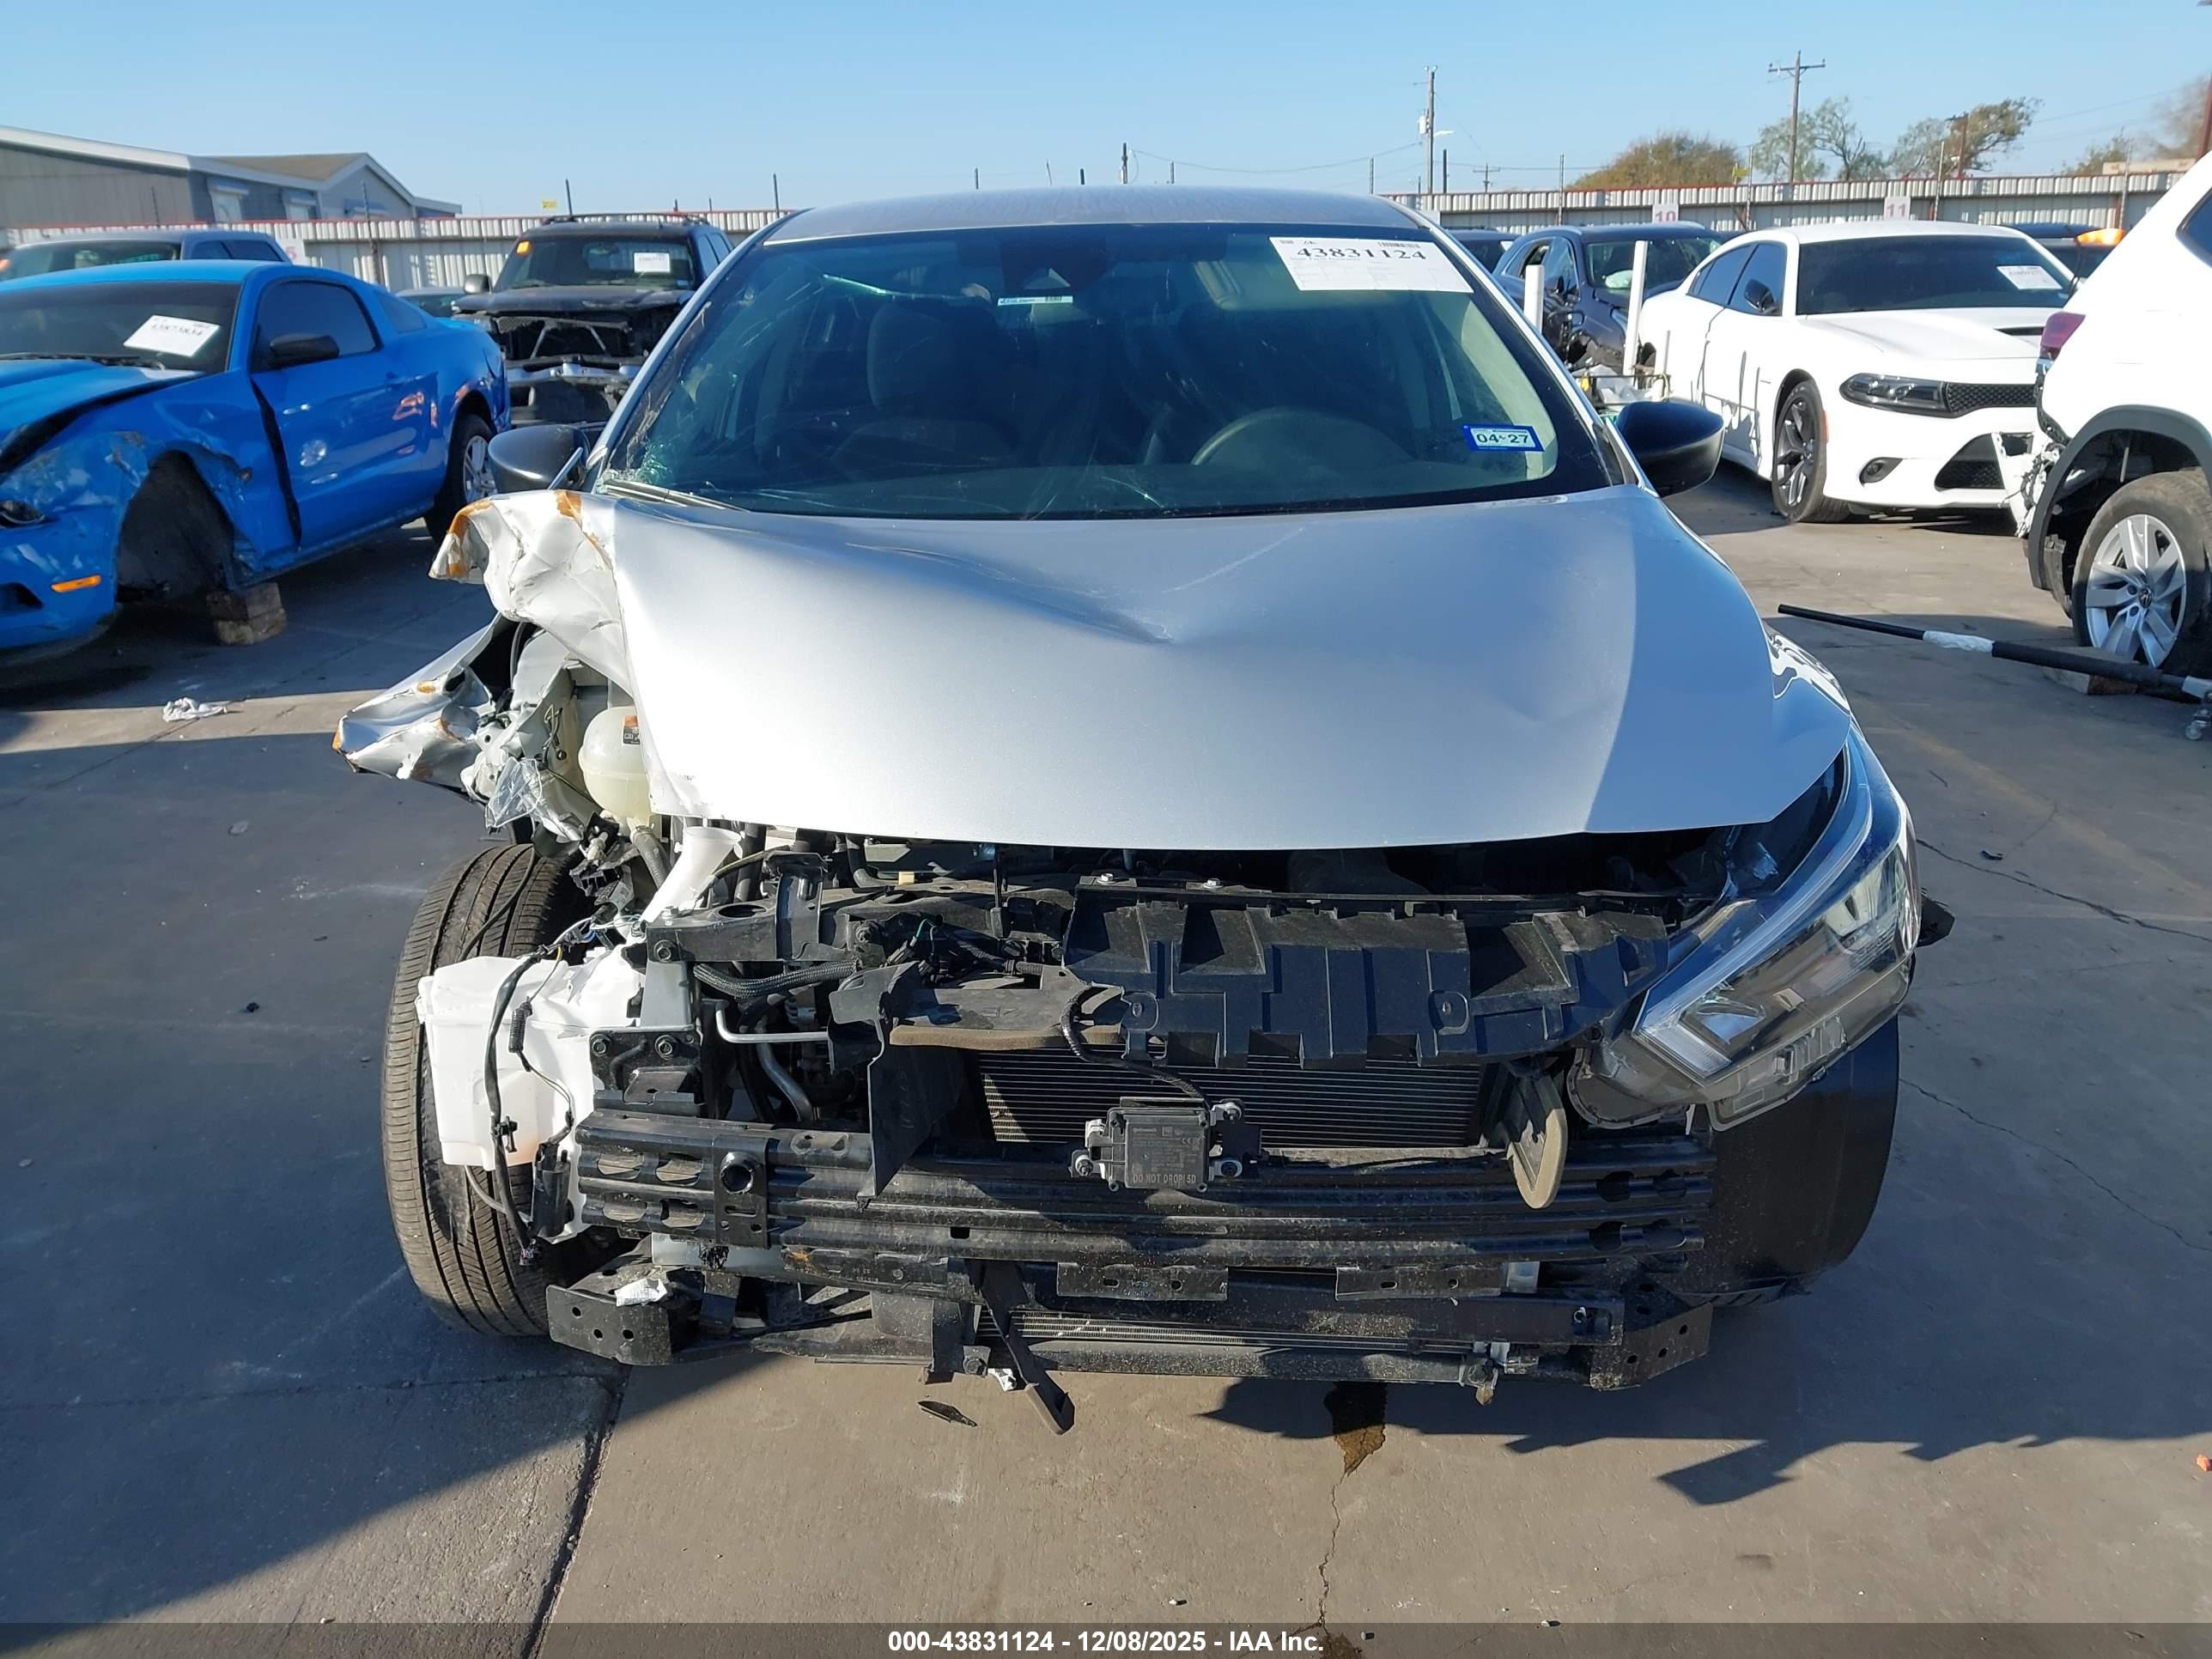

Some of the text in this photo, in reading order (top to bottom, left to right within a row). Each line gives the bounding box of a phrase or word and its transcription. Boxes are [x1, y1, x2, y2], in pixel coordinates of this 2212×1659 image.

[1655, 210, 1676, 222] 10
[1887, 203, 1906, 217] 11
[1297, 248, 1426, 260] 43831124
[1476, 433, 1528, 444] 04 27
[1133, 1174, 1144, 1183] DO
[1146, 1174, 1161, 1183] NOT
